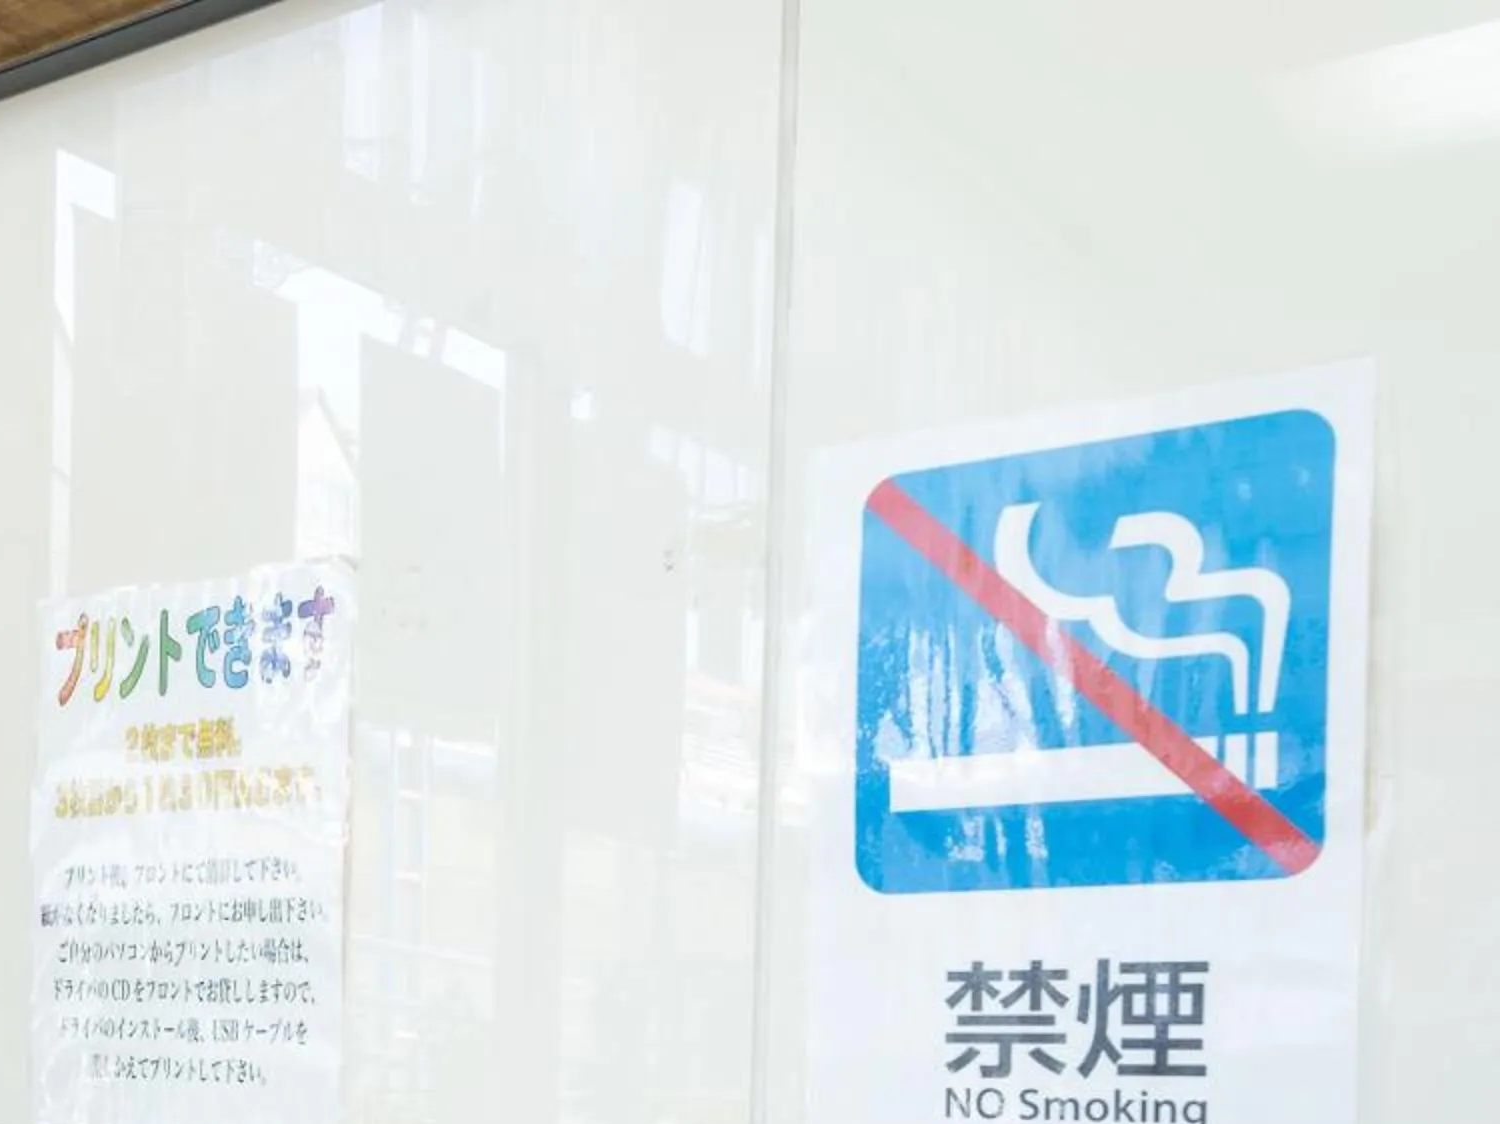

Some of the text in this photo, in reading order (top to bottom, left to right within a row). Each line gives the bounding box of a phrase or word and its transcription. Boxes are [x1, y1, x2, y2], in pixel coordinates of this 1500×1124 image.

[55, 585, 335, 706] プリントできます
[944, 957, 1210, 1080] 禁煙
[88, 1050, 268, 1086] かえてプリントして下さい。
[944, 1086, 1006, 1120] NO
